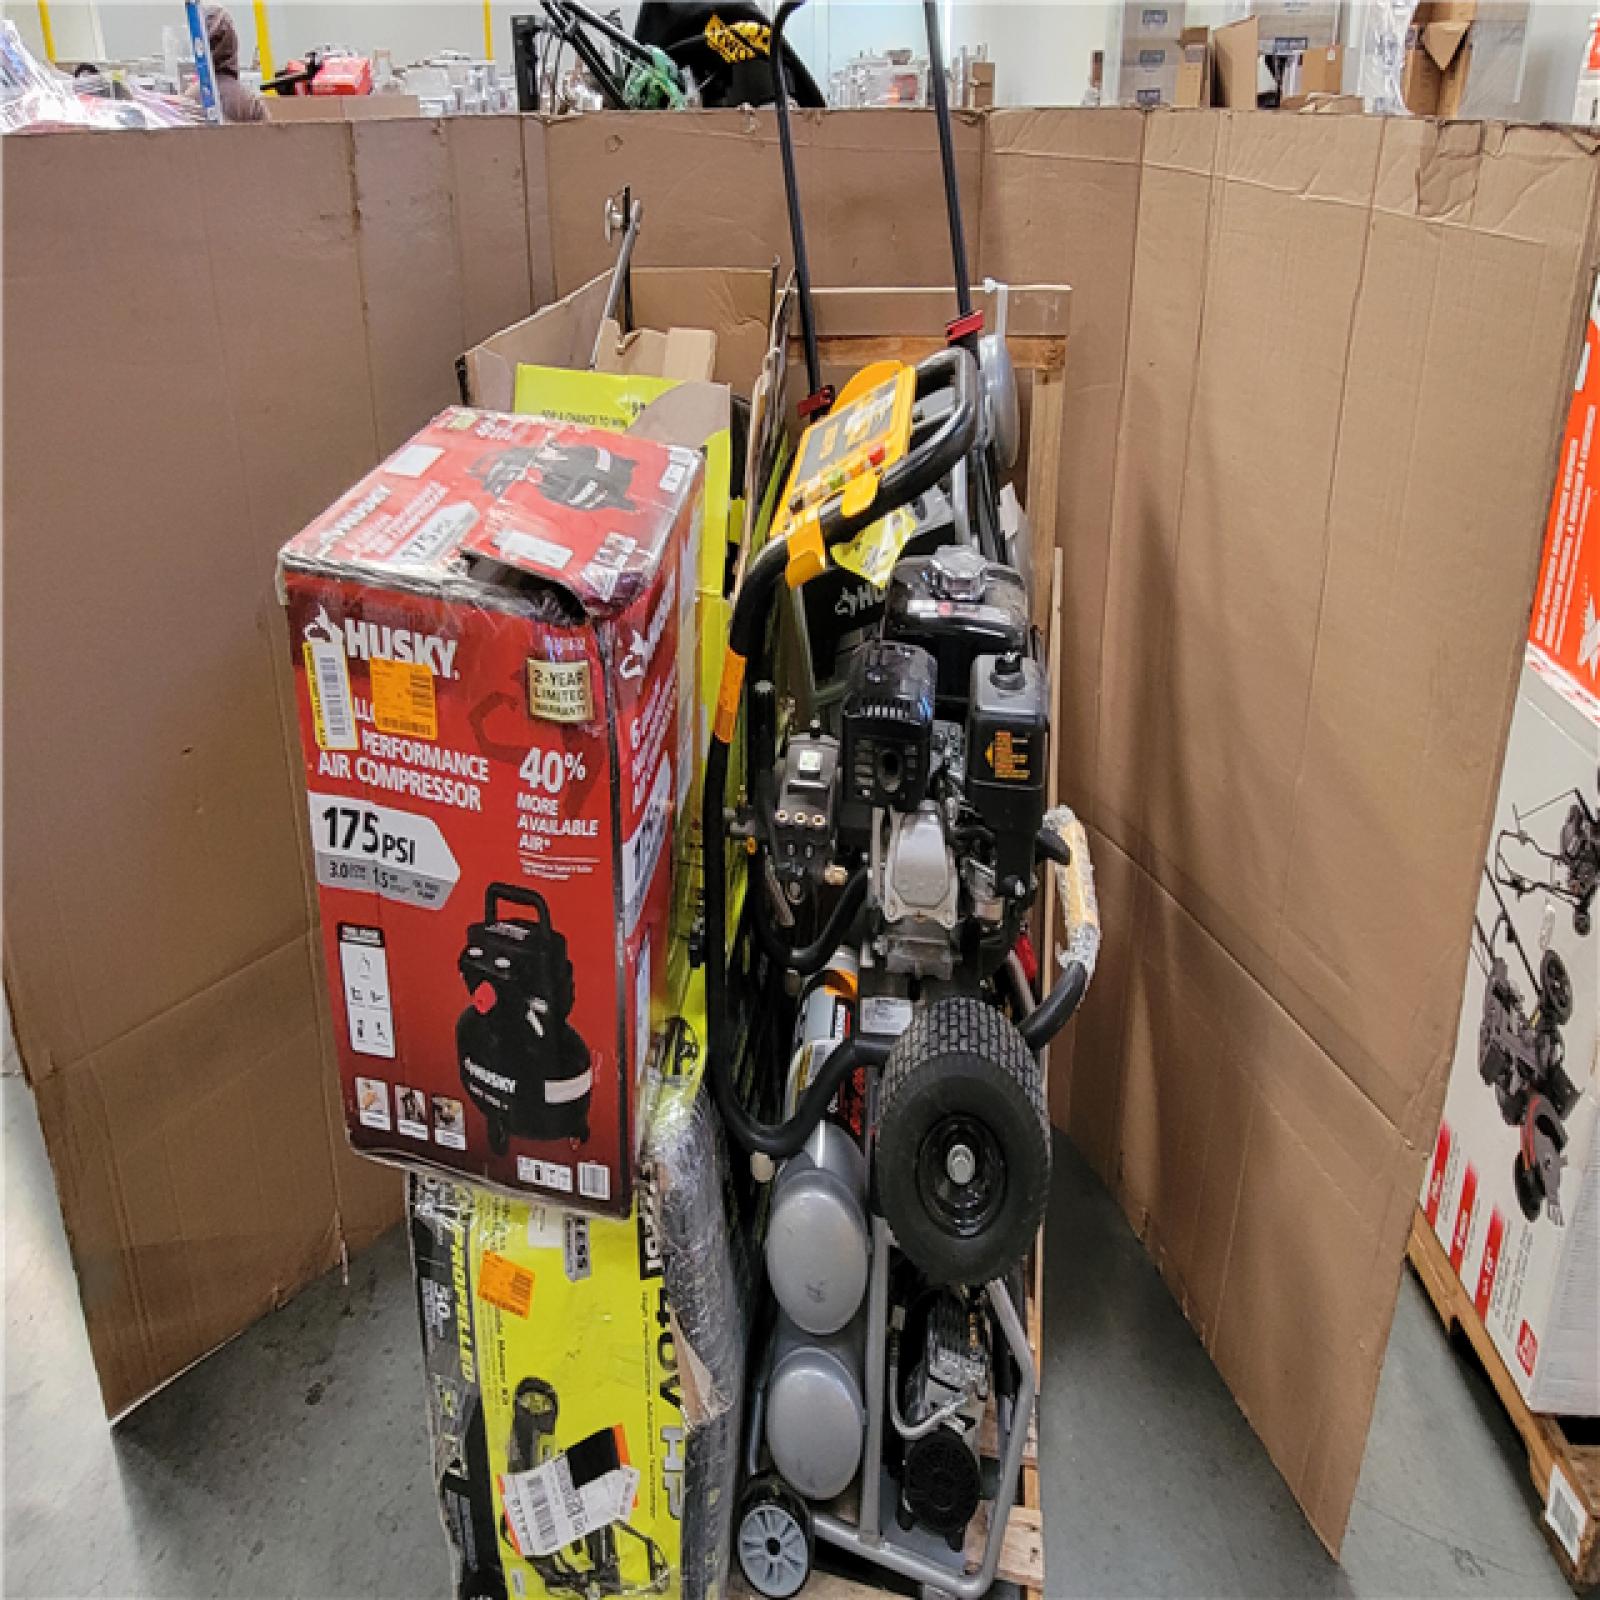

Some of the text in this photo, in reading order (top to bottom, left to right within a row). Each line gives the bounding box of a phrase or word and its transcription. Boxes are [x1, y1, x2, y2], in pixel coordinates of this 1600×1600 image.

[318, 752, 481, 811] AIR COMPRESSOR
[362, 729, 489, 782] PERFORMANCE
[517, 792, 558, 816] MORE
[517, 814, 598, 836] AVAILABLE
[323, 807, 416, 865] 175 PSI
